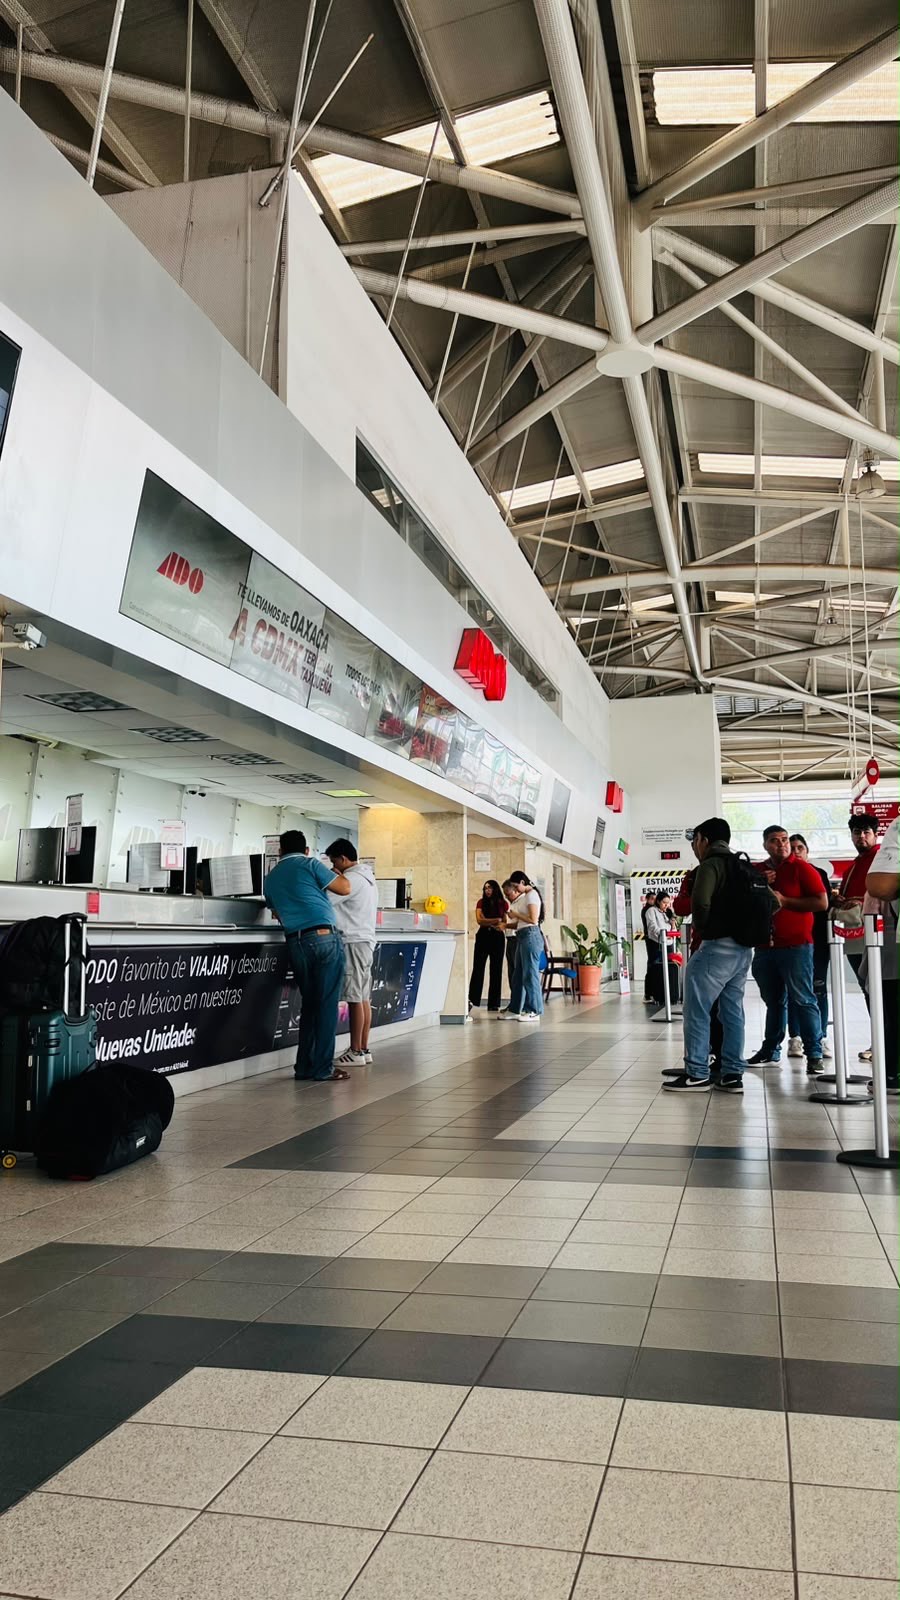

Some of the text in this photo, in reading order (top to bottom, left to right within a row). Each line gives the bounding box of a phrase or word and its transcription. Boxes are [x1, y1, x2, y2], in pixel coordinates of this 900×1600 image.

[156, 551, 204, 594] ADO
[237, 581, 329, 653] TE LLEVAMOS DE OAXACA
[228, 607, 249, 647] A
[250, 618, 305, 677] CDMX
[345, 664, 361, 683] TODOS
[85, 953, 278, 984] ODO favorito de VIAJAR y descubre
[118, 993, 136, 1019] de
[137, 988, 182, 1017] México
[183, 992, 198, 1011] en
[198, 987, 243, 1009] nuestras
